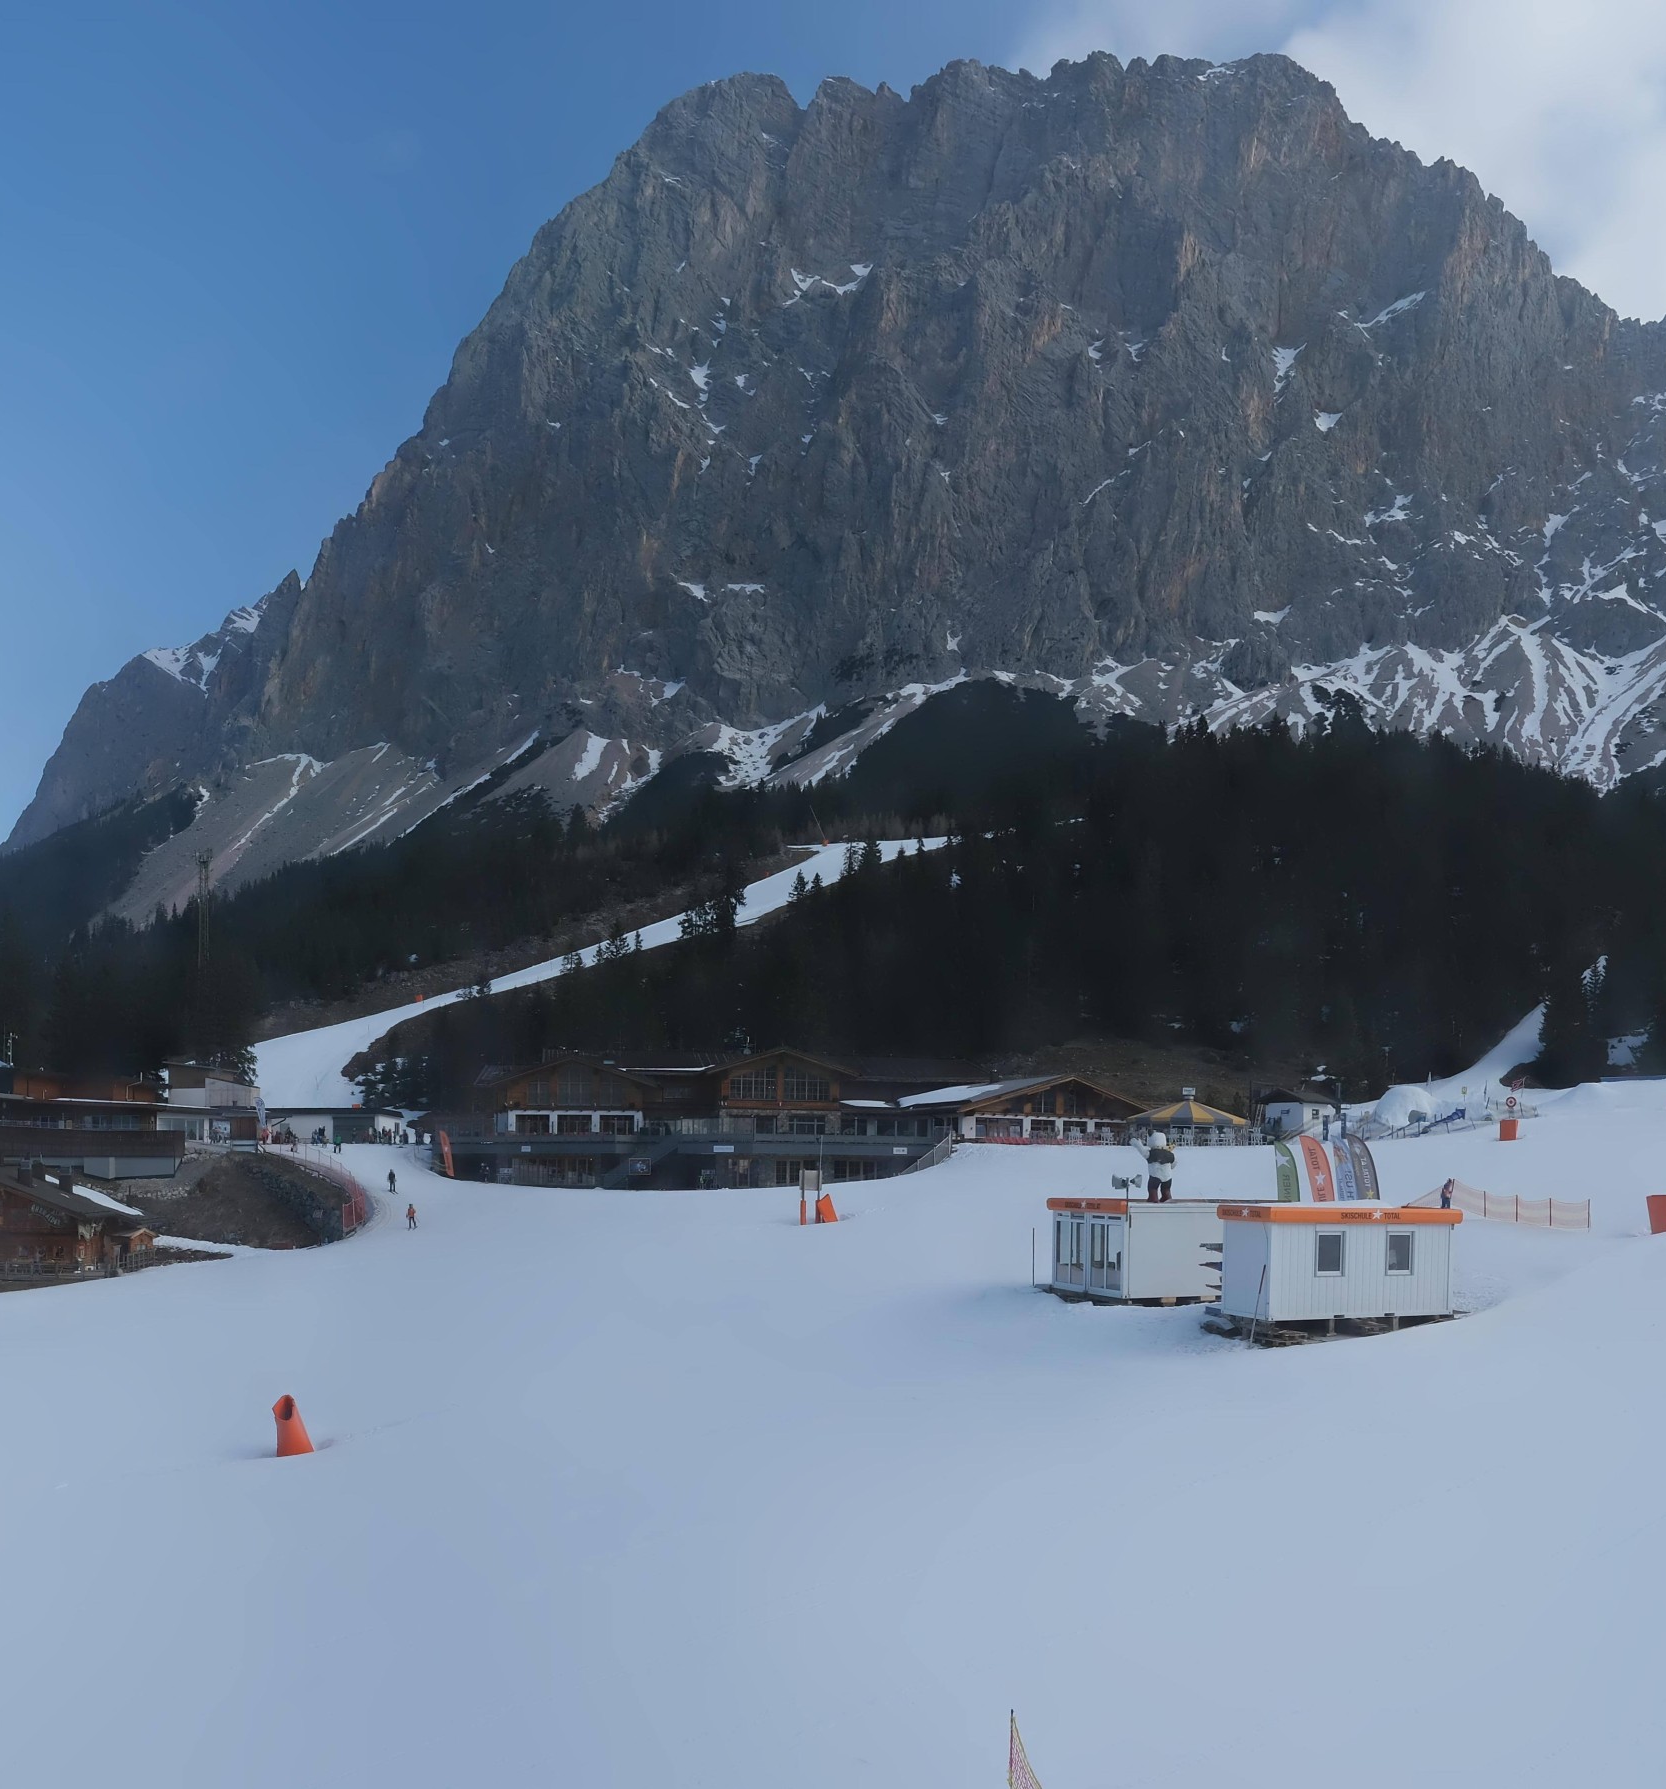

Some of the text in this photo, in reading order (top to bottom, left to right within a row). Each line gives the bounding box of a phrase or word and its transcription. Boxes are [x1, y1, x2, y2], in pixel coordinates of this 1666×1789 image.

[1222, 1208, 1261, 1218] SKISCHULE TOTAL
[1341, 1212, 1401, 1220] SKISCHULE TOTAL
